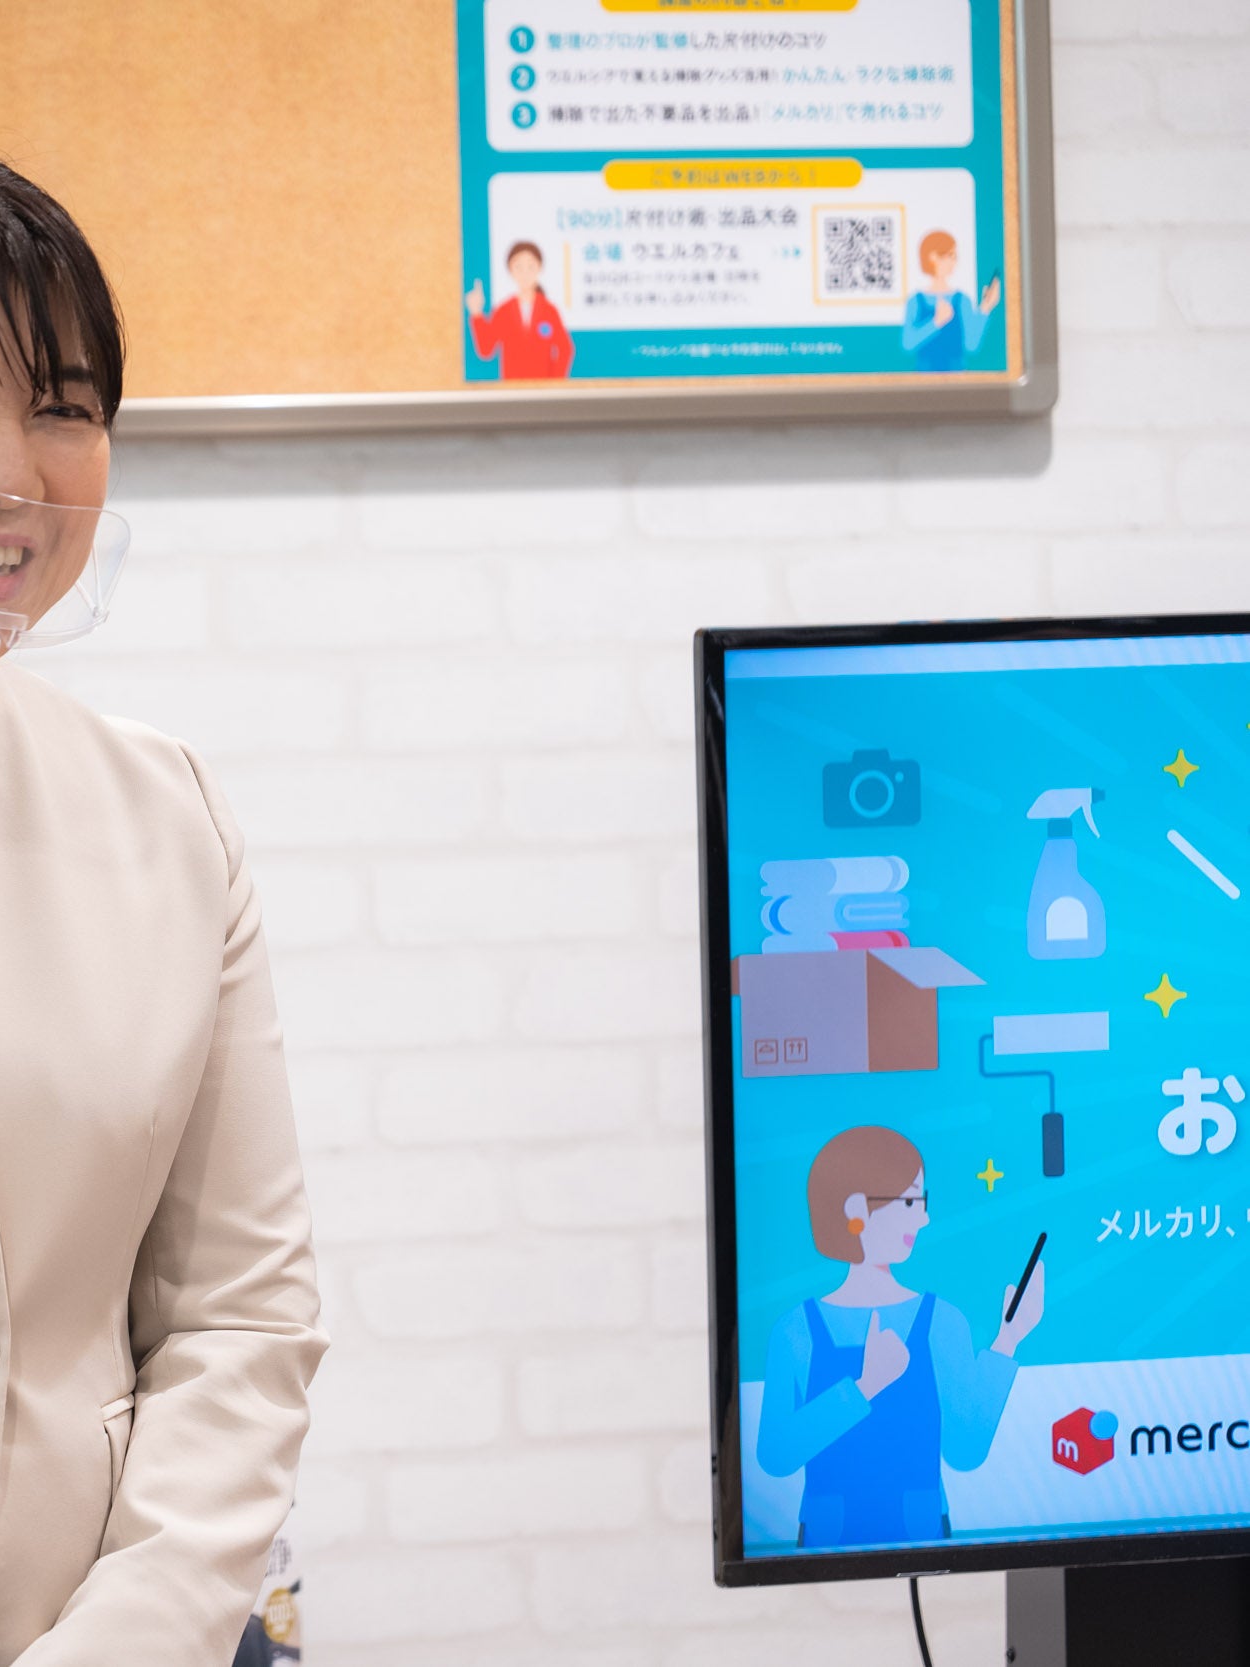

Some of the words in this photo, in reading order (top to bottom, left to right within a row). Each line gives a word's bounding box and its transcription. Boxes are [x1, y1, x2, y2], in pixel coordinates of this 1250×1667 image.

[1157, 1067, 1246, 1156] お
[1096, 1204, 1250, 1243] メルカリ、
[1130, 1419, 1250, 1456] merc
